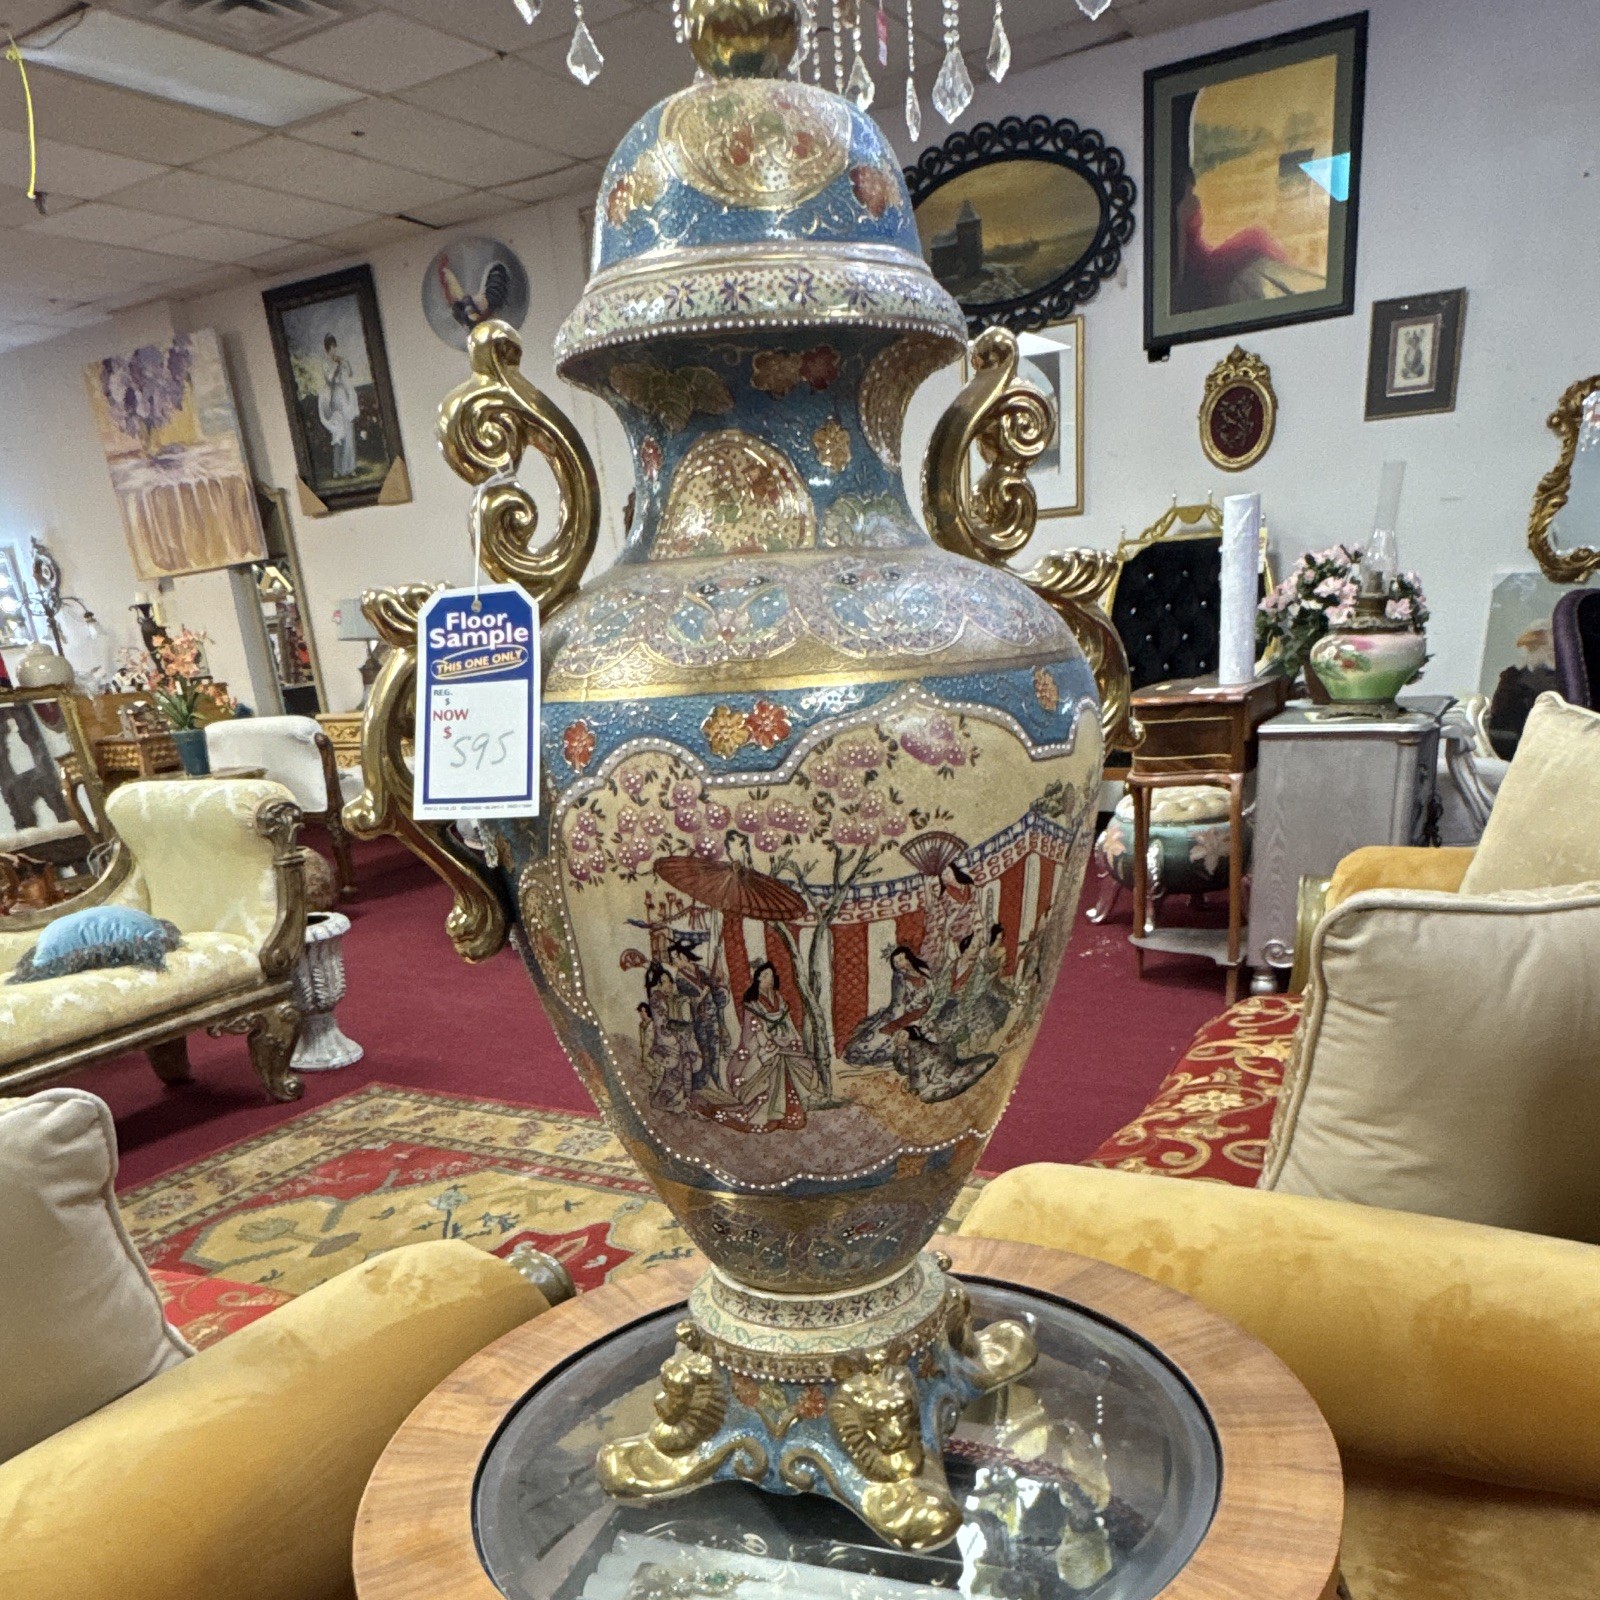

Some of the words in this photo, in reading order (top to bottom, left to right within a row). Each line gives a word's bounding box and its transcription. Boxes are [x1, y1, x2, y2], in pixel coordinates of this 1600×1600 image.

[446, 612, 508, 631] Floor
[430, 625, 529, 650] Sample
[436, 658, 462, 674] THIS
[464, 654, 489, 669] ONE
[493, 649, 523, 664] ONLY
[433, 709, 469, 721] NOW
[443, 727, 452, 739] $
[451, 731, 514, 770] 595
